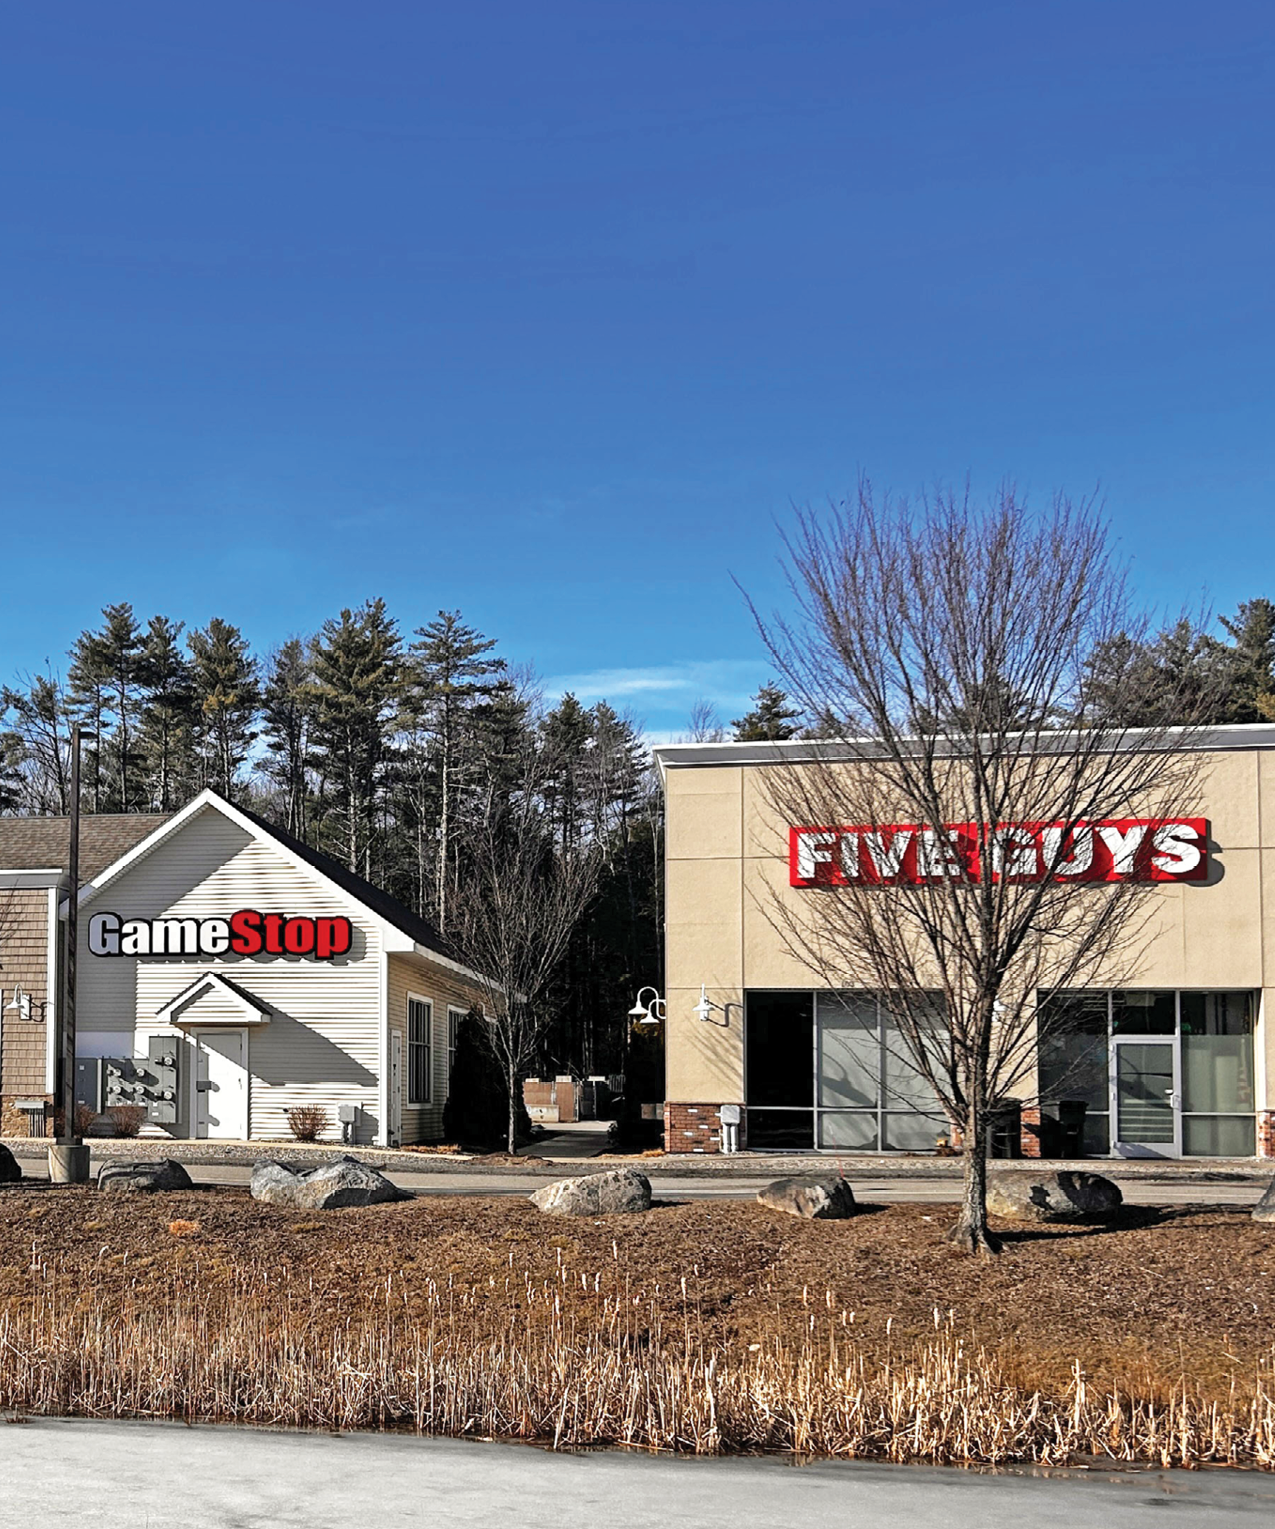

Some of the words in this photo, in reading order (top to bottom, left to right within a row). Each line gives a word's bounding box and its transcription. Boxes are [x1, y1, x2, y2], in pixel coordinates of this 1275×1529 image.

[797, 830, 961, 878] FIVE
[991, 824, 1199, 876] GUYS
[88, 910, 351, 959] GameStop
